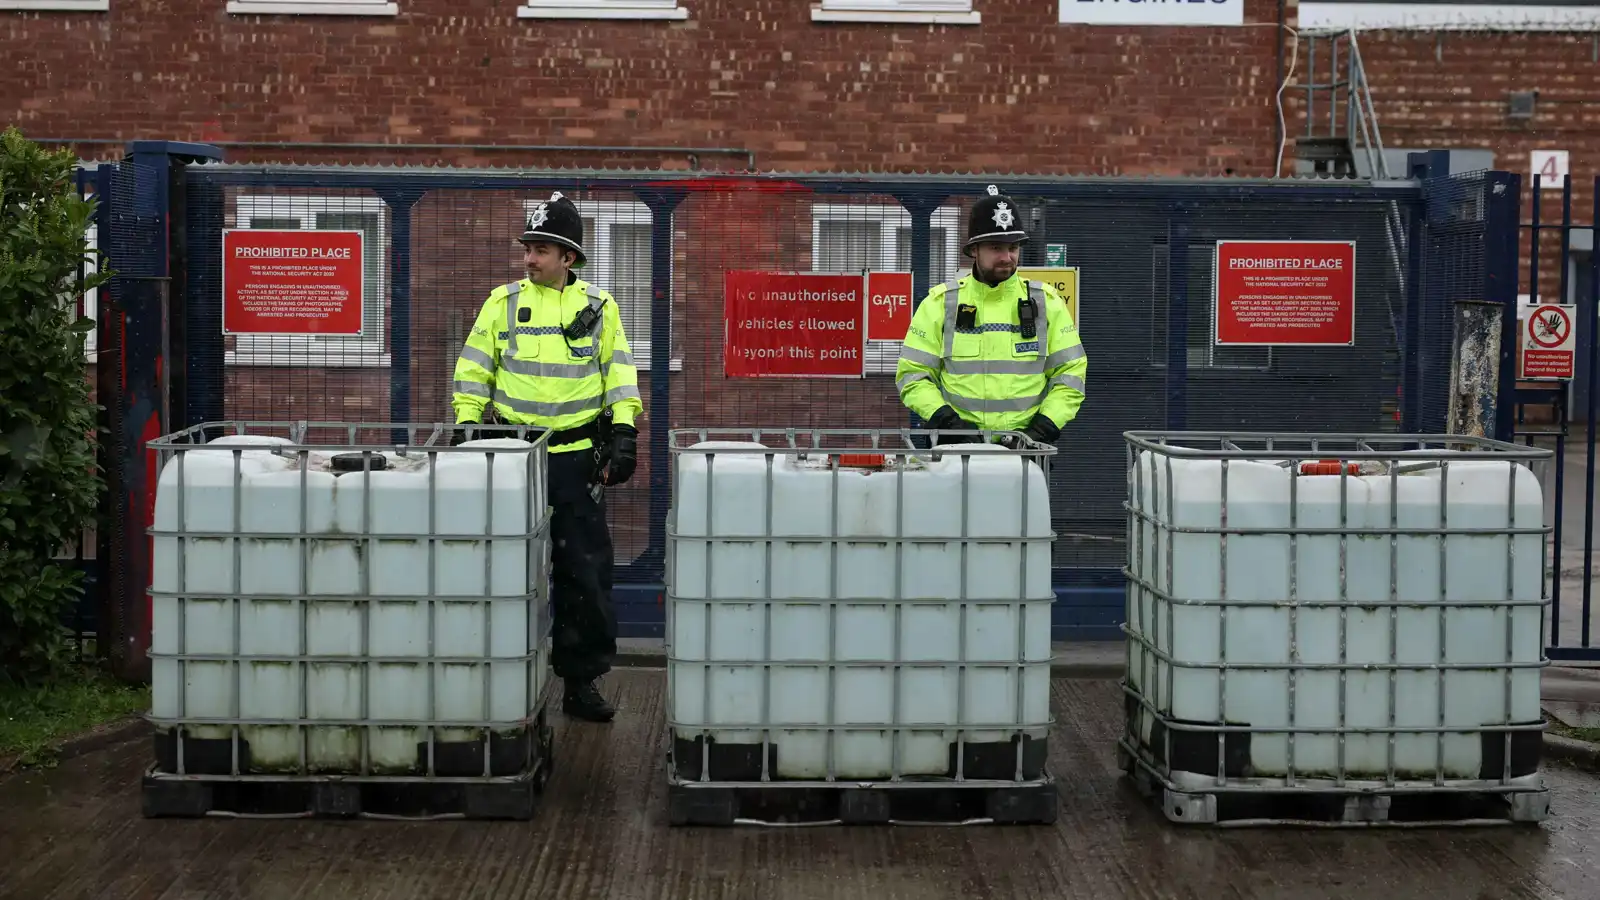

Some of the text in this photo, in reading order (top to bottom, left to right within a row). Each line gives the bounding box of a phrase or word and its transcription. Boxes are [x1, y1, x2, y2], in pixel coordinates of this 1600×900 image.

[1540, 156, 1558, 182] 4
[235, 247, 351, 258] PROHIBITED PLACE
[1230, 258, 1342, 268] PROHIBITED PLACE
[762, 289, 856, 302] unauthorised
[872, 295, 907, 306] GATE
[738, 318, 855, 330] vehicles allowed
[1016, 343, 1038, 351] POLICE
[789, 346, 814, 358] this
[820, 347, 857, 360] point
